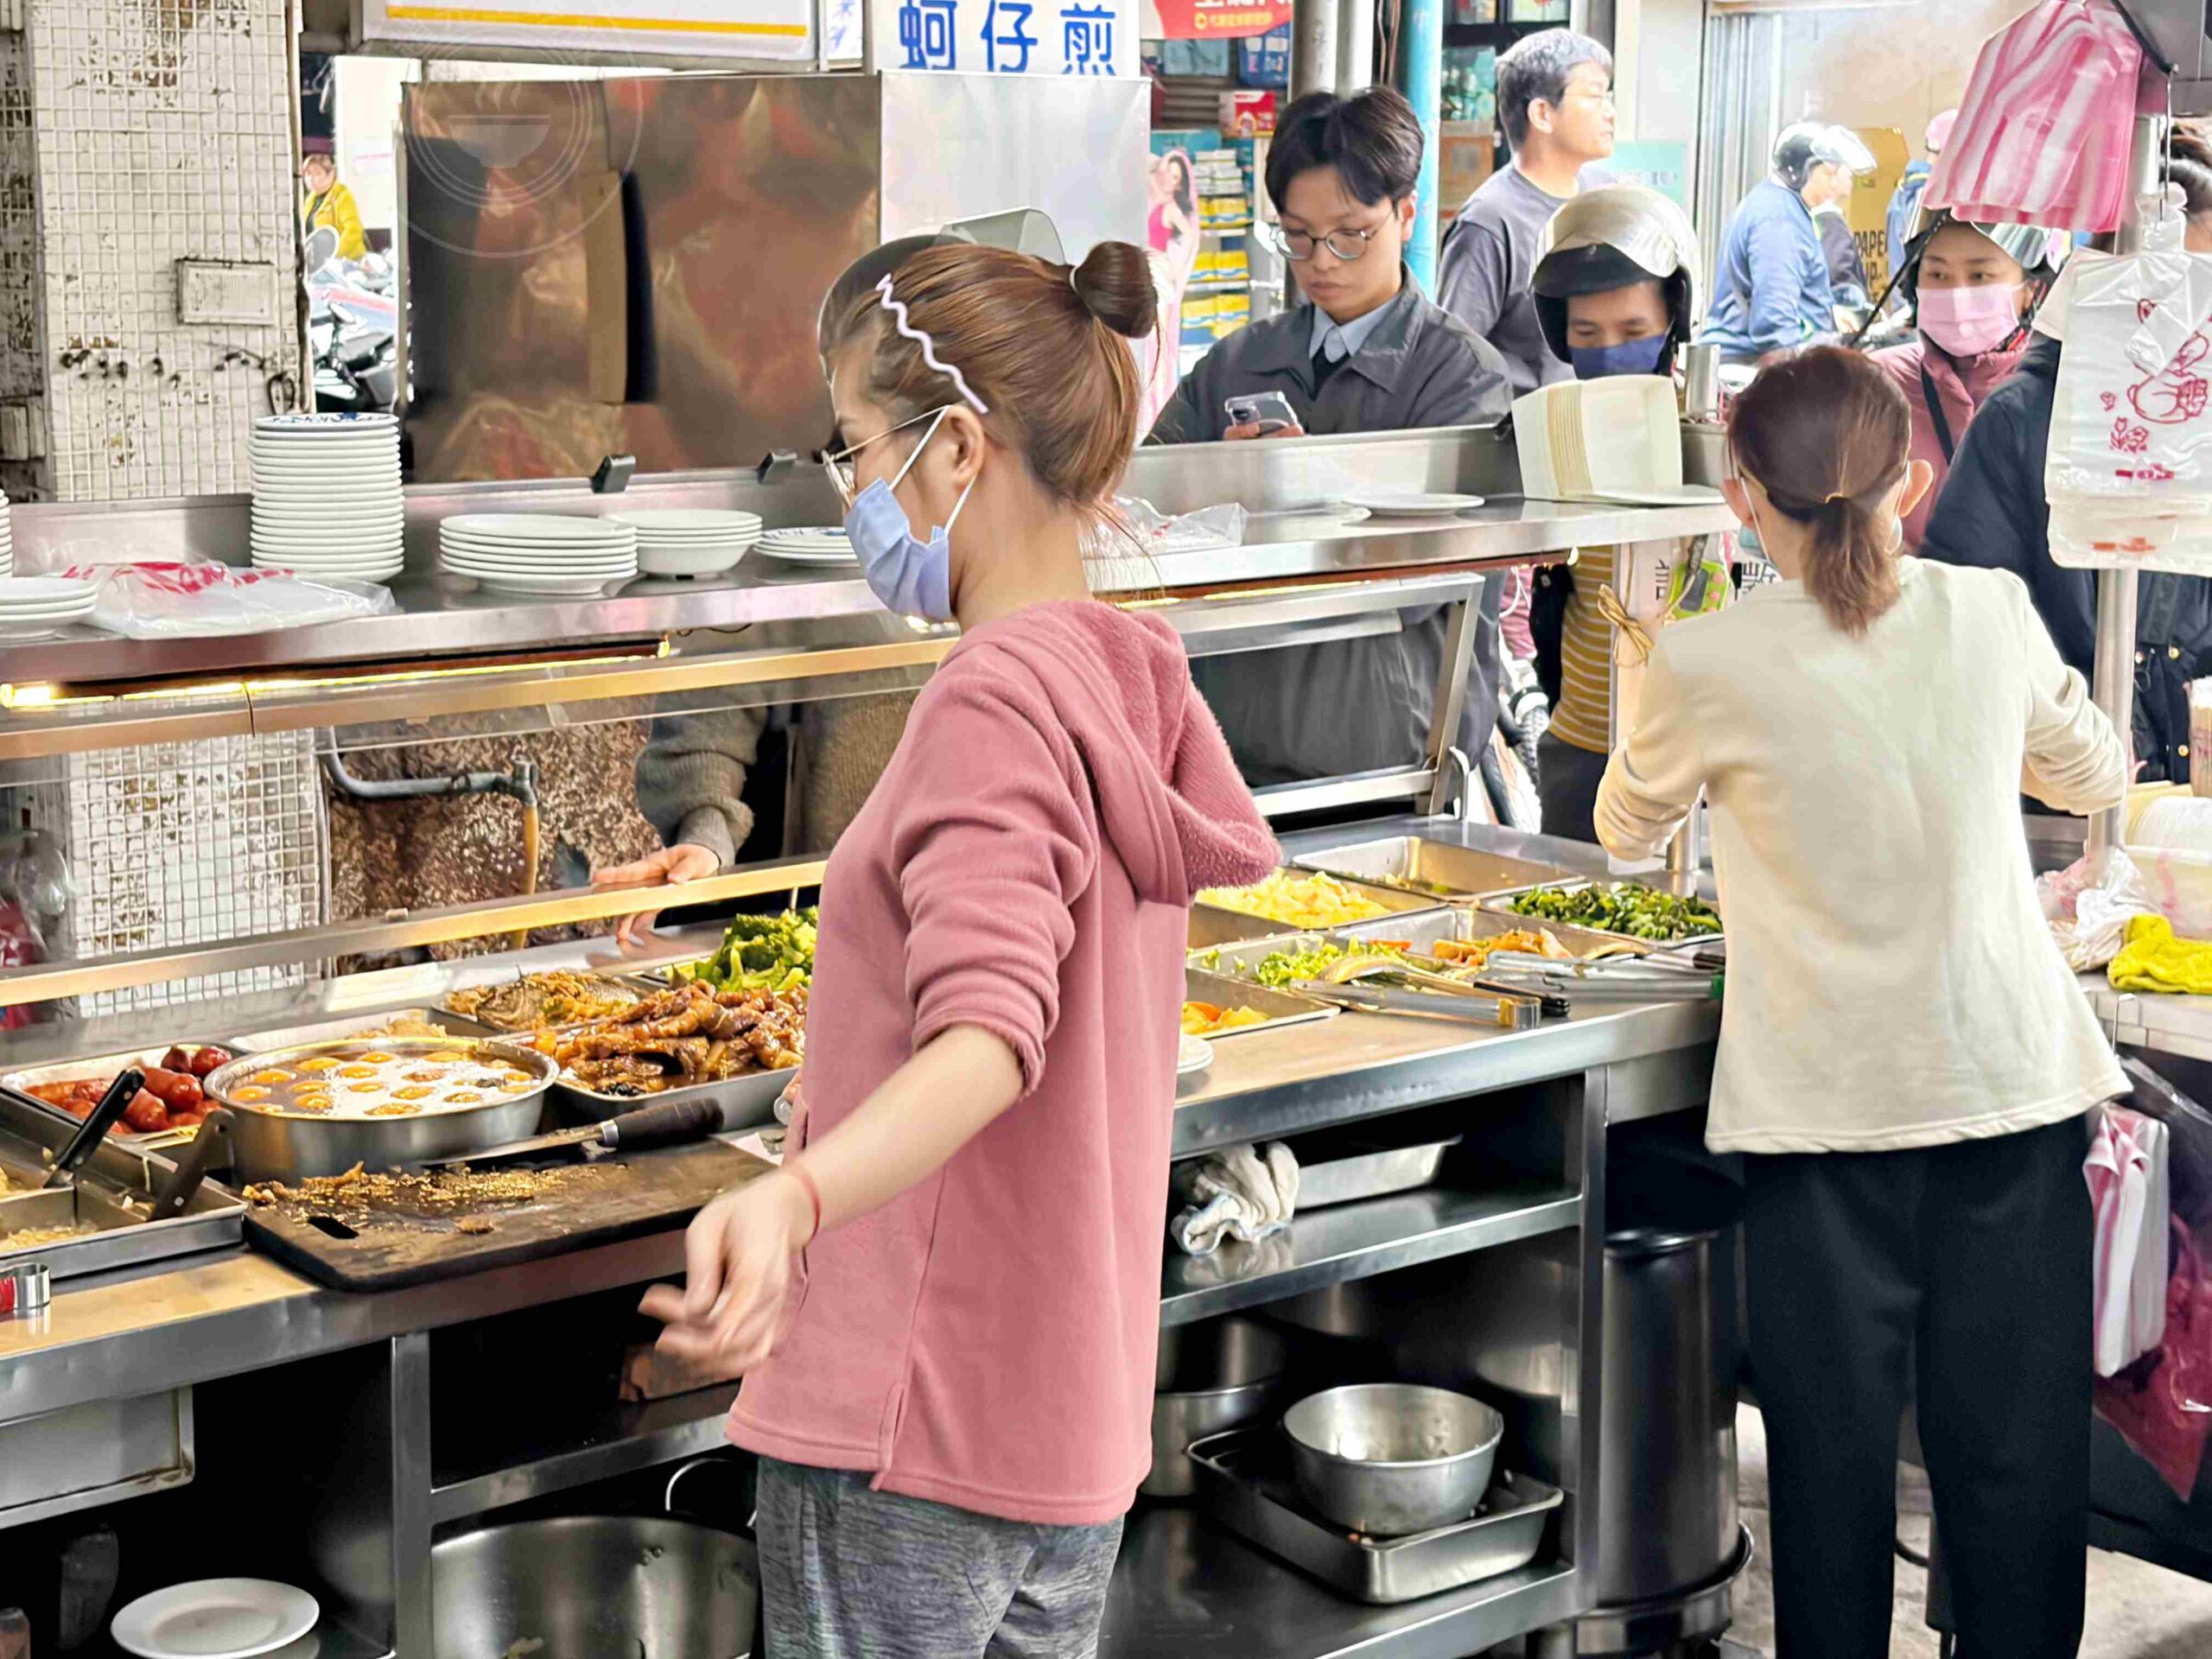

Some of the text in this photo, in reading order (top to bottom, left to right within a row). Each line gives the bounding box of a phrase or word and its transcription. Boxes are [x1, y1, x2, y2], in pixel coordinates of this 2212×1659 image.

[899, 0, 1117, 76] 蚵仔煎
[1853, 230, 1887, 257] PAPE
